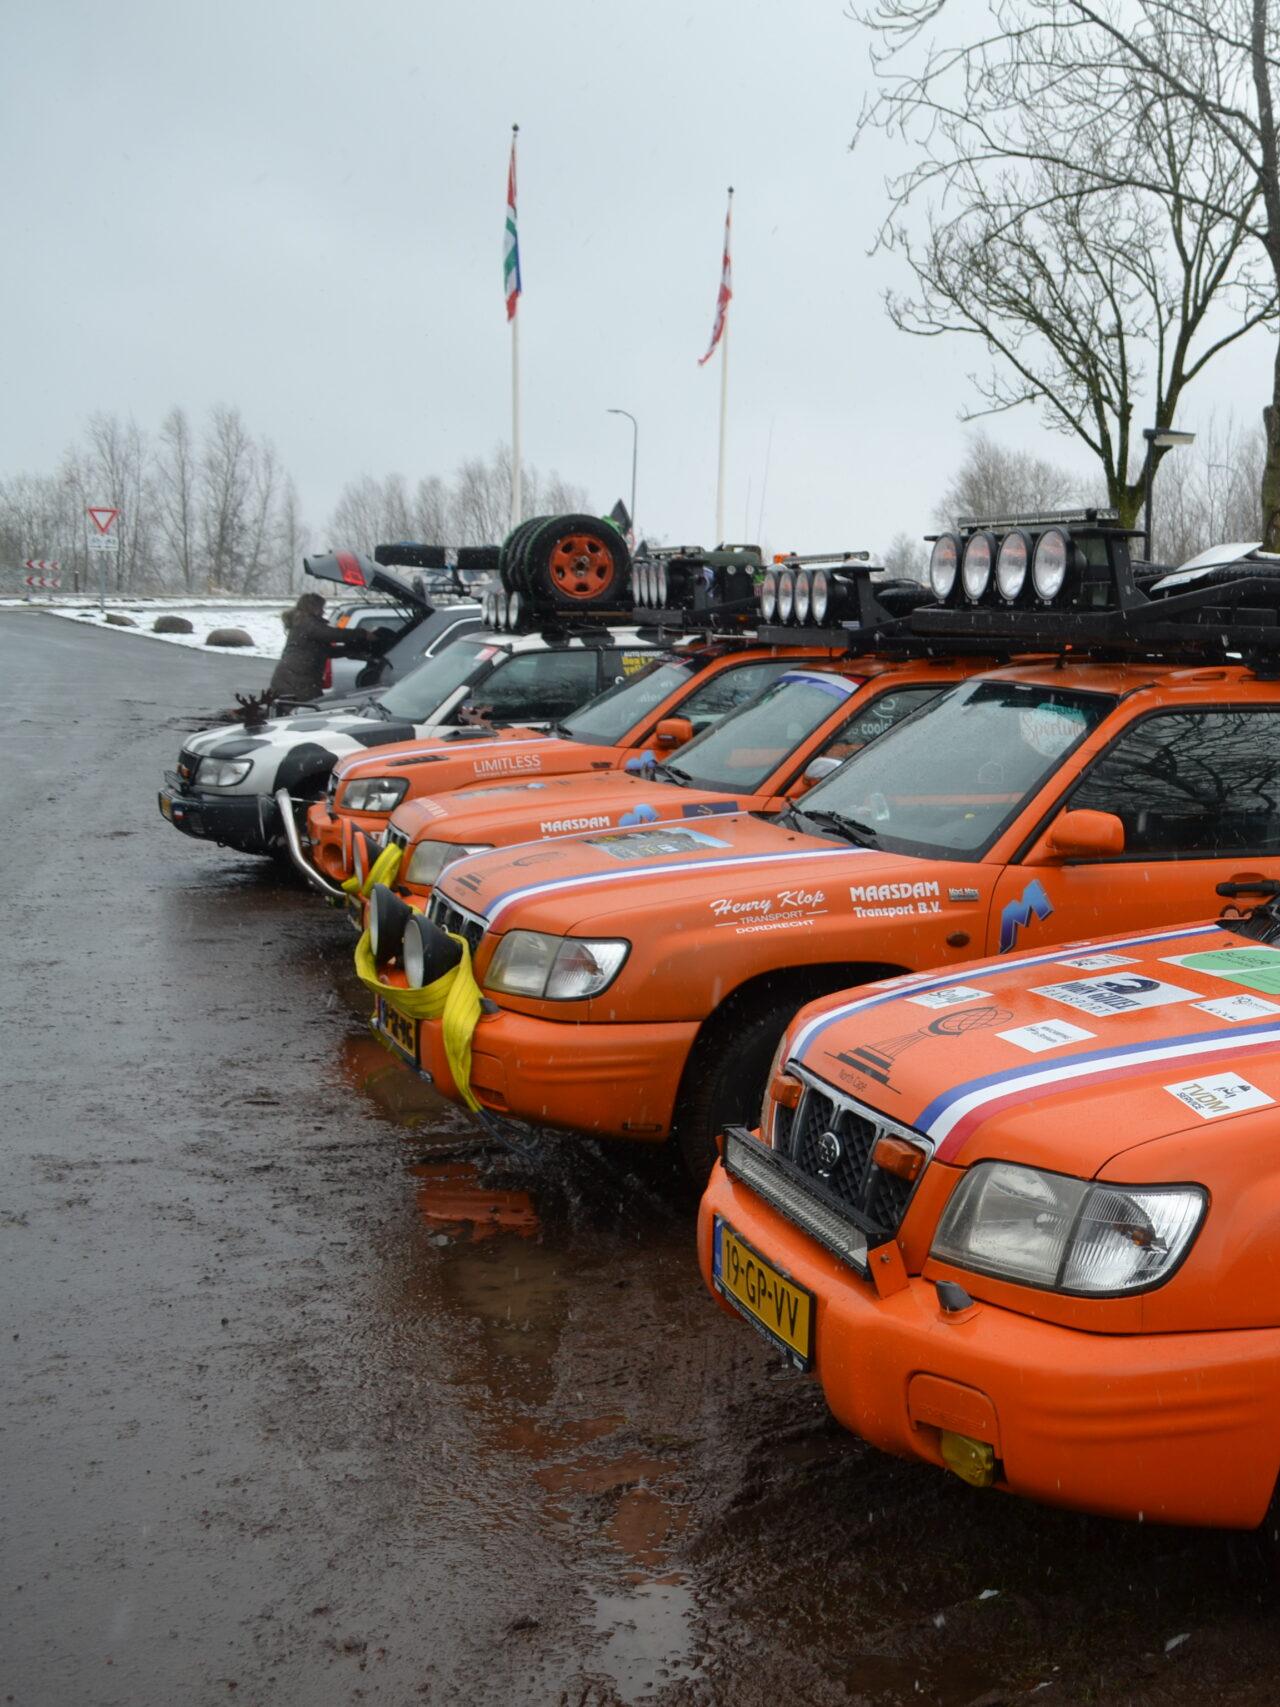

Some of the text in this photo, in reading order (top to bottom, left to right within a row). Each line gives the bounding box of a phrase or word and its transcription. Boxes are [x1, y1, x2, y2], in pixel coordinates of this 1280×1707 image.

[473, 754, 541, 773] LIMITLESS
[540, 816, 611, 833] MAASDAM
[849, 881, 940, 902] MAASDAM
[709, 889, 826, 916] Henry Klop
[853, 901, 942, 919] Transport B.V.
[736, 919, 815, 934] DORDRECHT
[740, 910, 804, 925] TRANSPORT
[726, 1238, 799, 1339] 19-GP-VV
